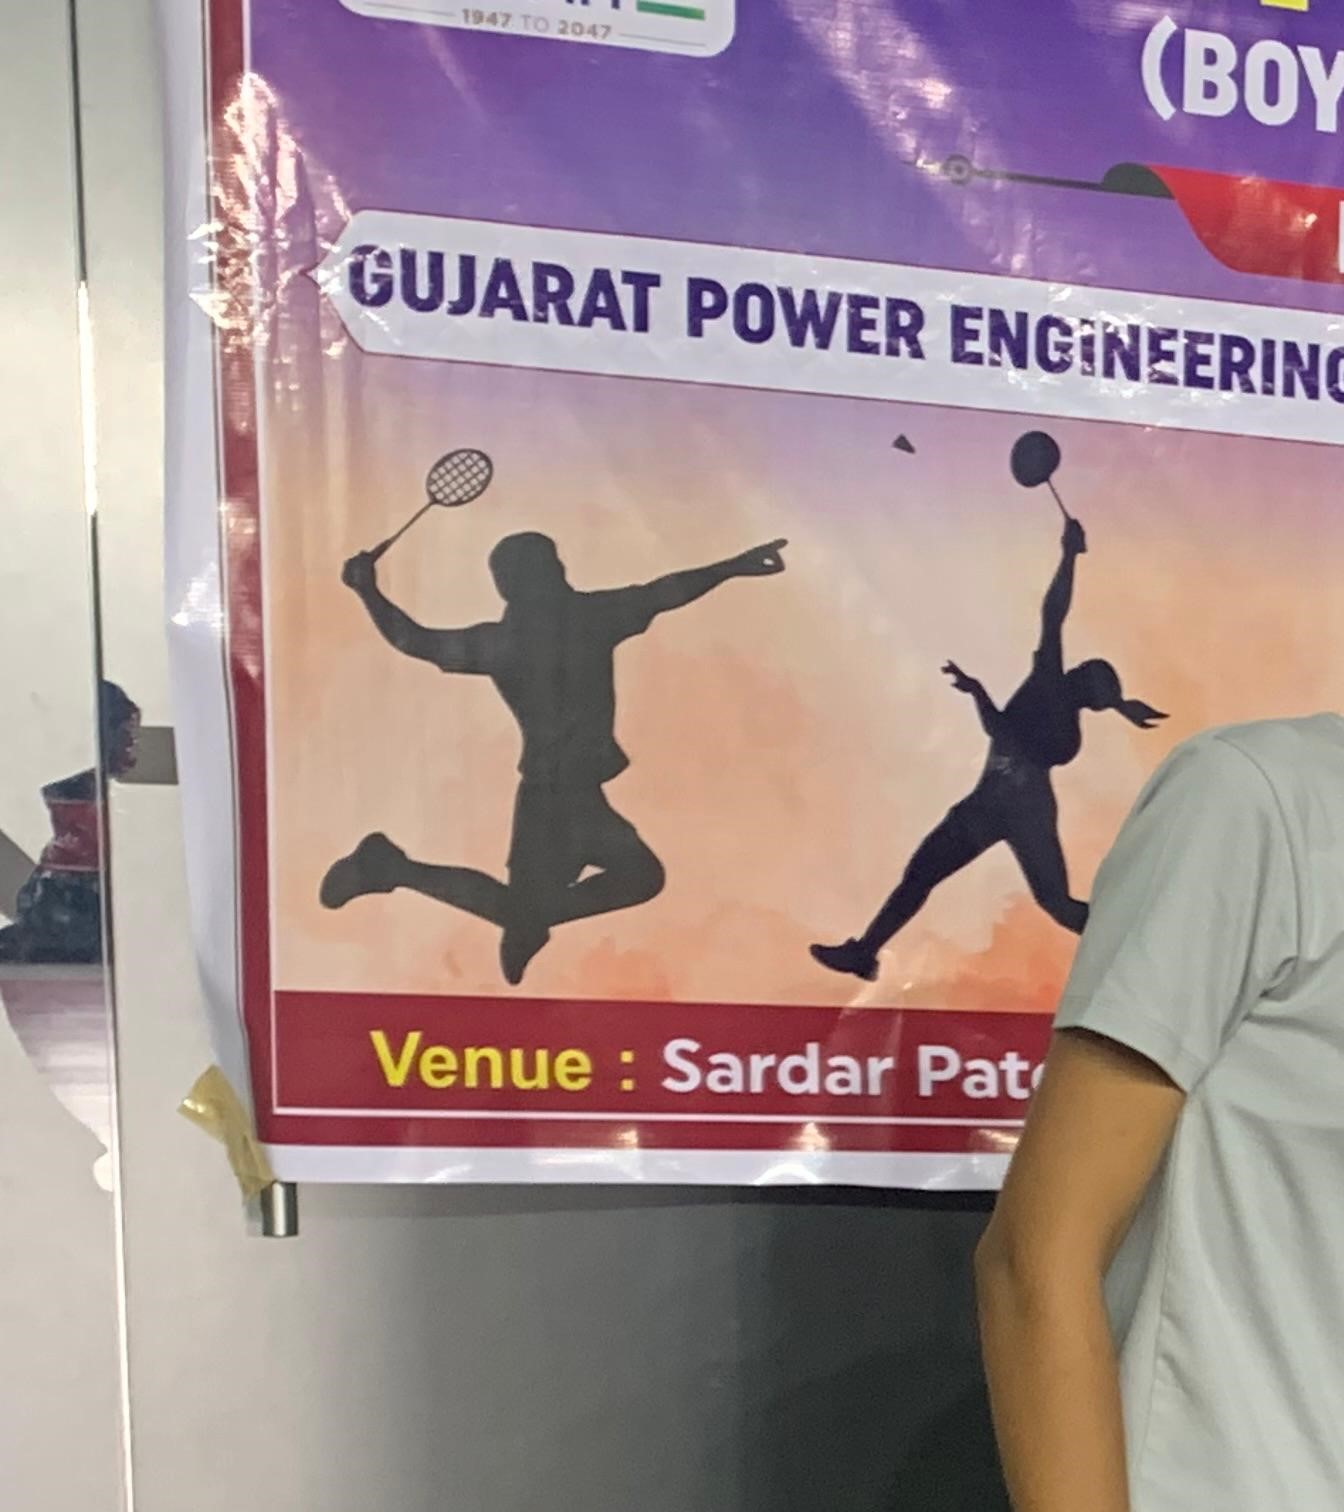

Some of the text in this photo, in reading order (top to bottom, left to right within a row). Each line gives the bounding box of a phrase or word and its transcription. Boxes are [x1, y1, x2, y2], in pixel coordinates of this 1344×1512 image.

[462, 8, 612, 39] 1947 TO 2047
[348, 243, 661, 333] GUJARAT
[687, 276, 926, 361] POWER
[371, 1029, 592, 1091] Venue
[661, 1037, 894, 1098] Sardar
[917, 1044, 1046, 1100] Pat
